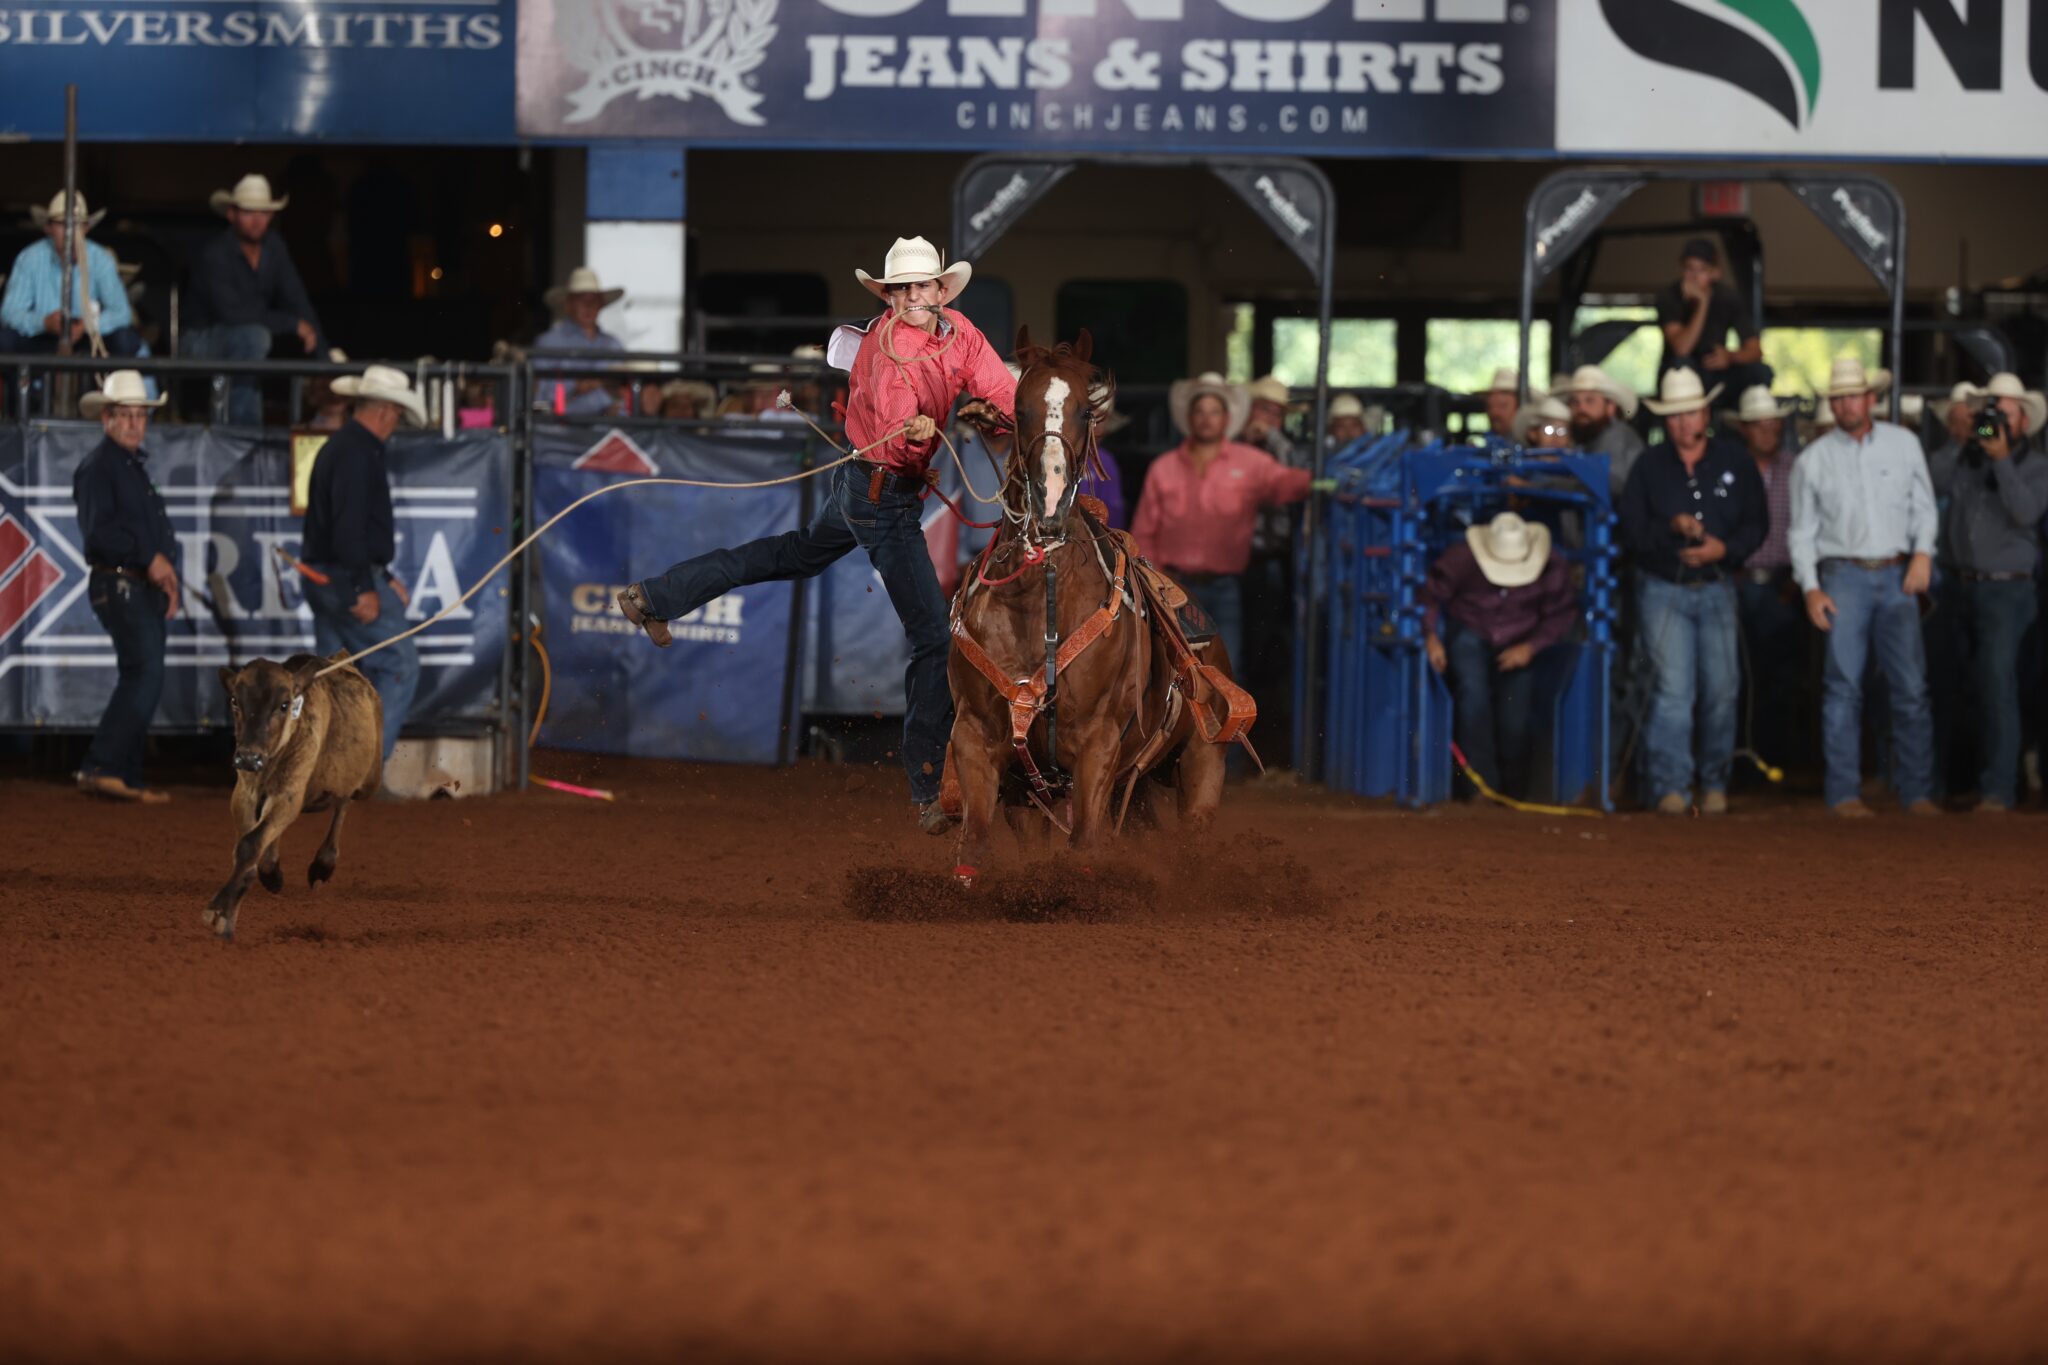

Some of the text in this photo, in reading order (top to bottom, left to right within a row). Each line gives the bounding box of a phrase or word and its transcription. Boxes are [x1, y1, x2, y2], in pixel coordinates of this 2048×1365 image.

[611, 59, 717, 86] CINCH
[804, 36, 1504, 100] JEANS & SHIRTS
[956, 101, 1368, 133] CINCHJEANS.COM
[667, 621, 740, 644] HIRTS
